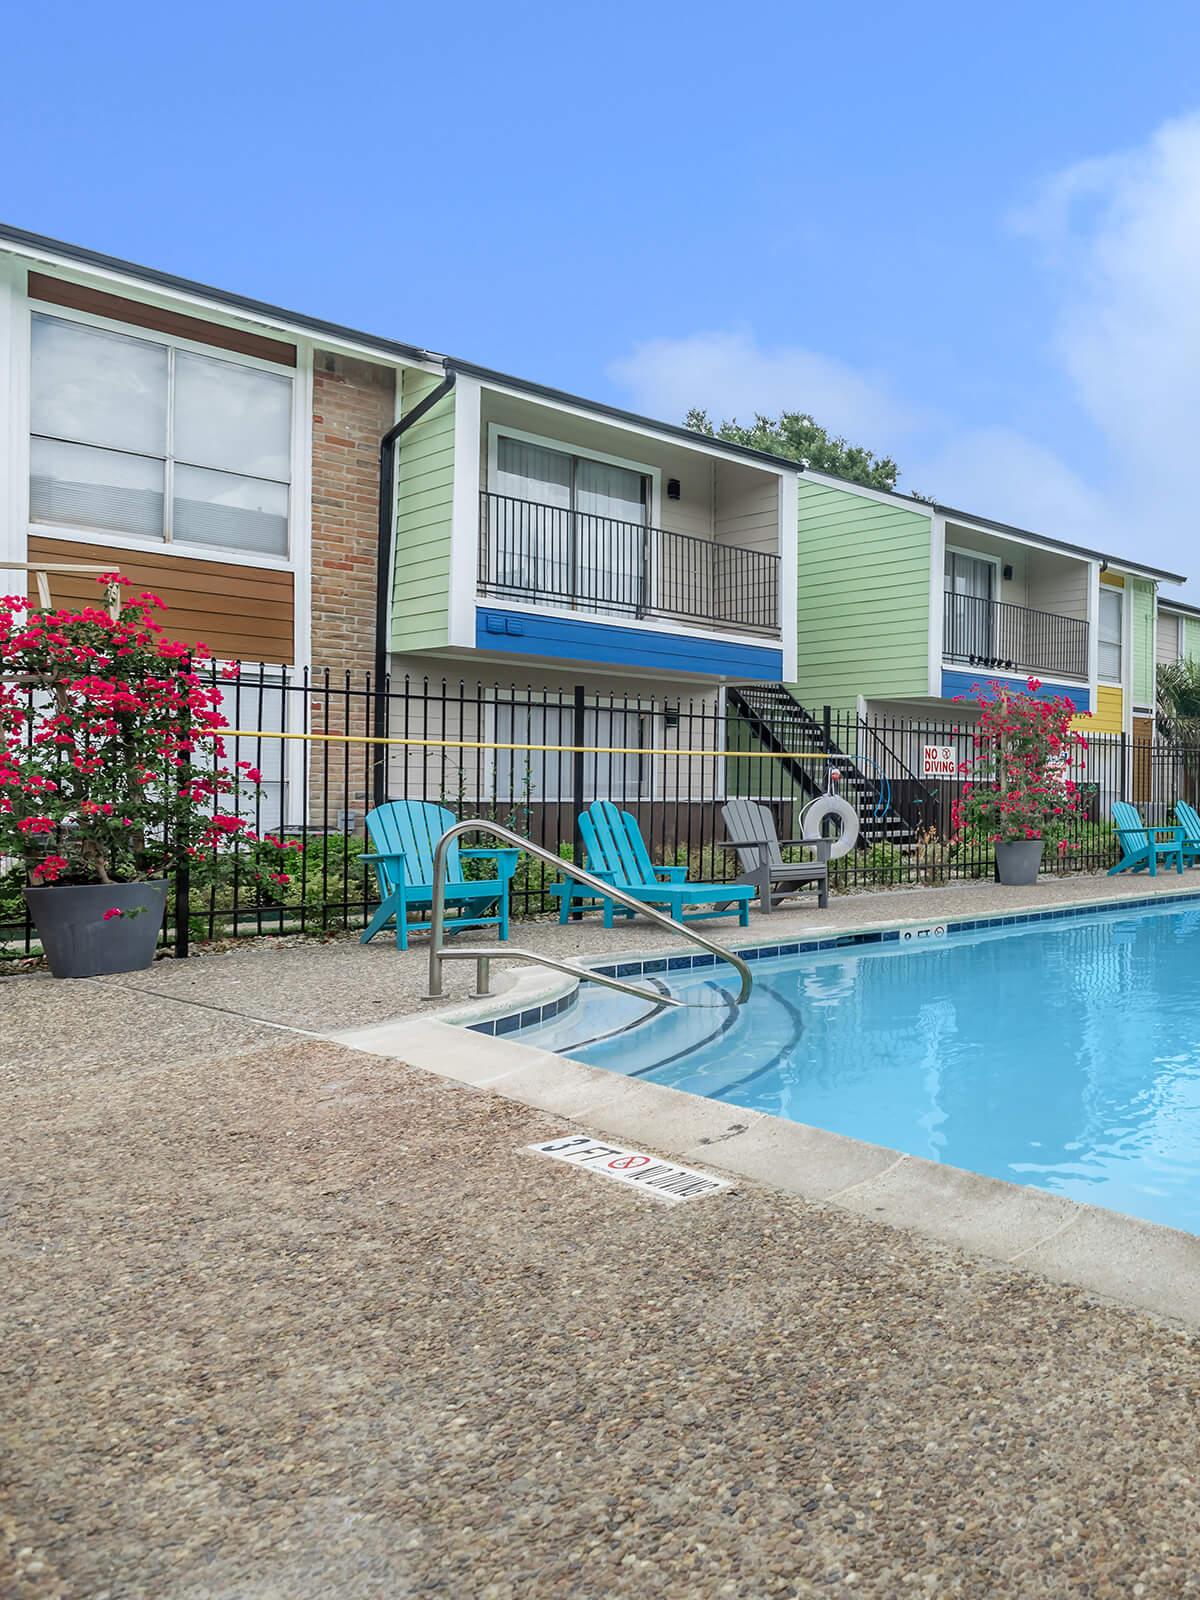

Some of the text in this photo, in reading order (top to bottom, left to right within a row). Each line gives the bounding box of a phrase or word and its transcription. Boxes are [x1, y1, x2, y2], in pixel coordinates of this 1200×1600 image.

[925, 748, 938, 759] NO
[925, 761, 954, 772] DIVING
[541, 1138, 591, 1152] 3
[563, 1147, 623, 1162] FT
[624, 1164, 673, 1181] NO
[645, 1171, 720, 1198] DIVING
